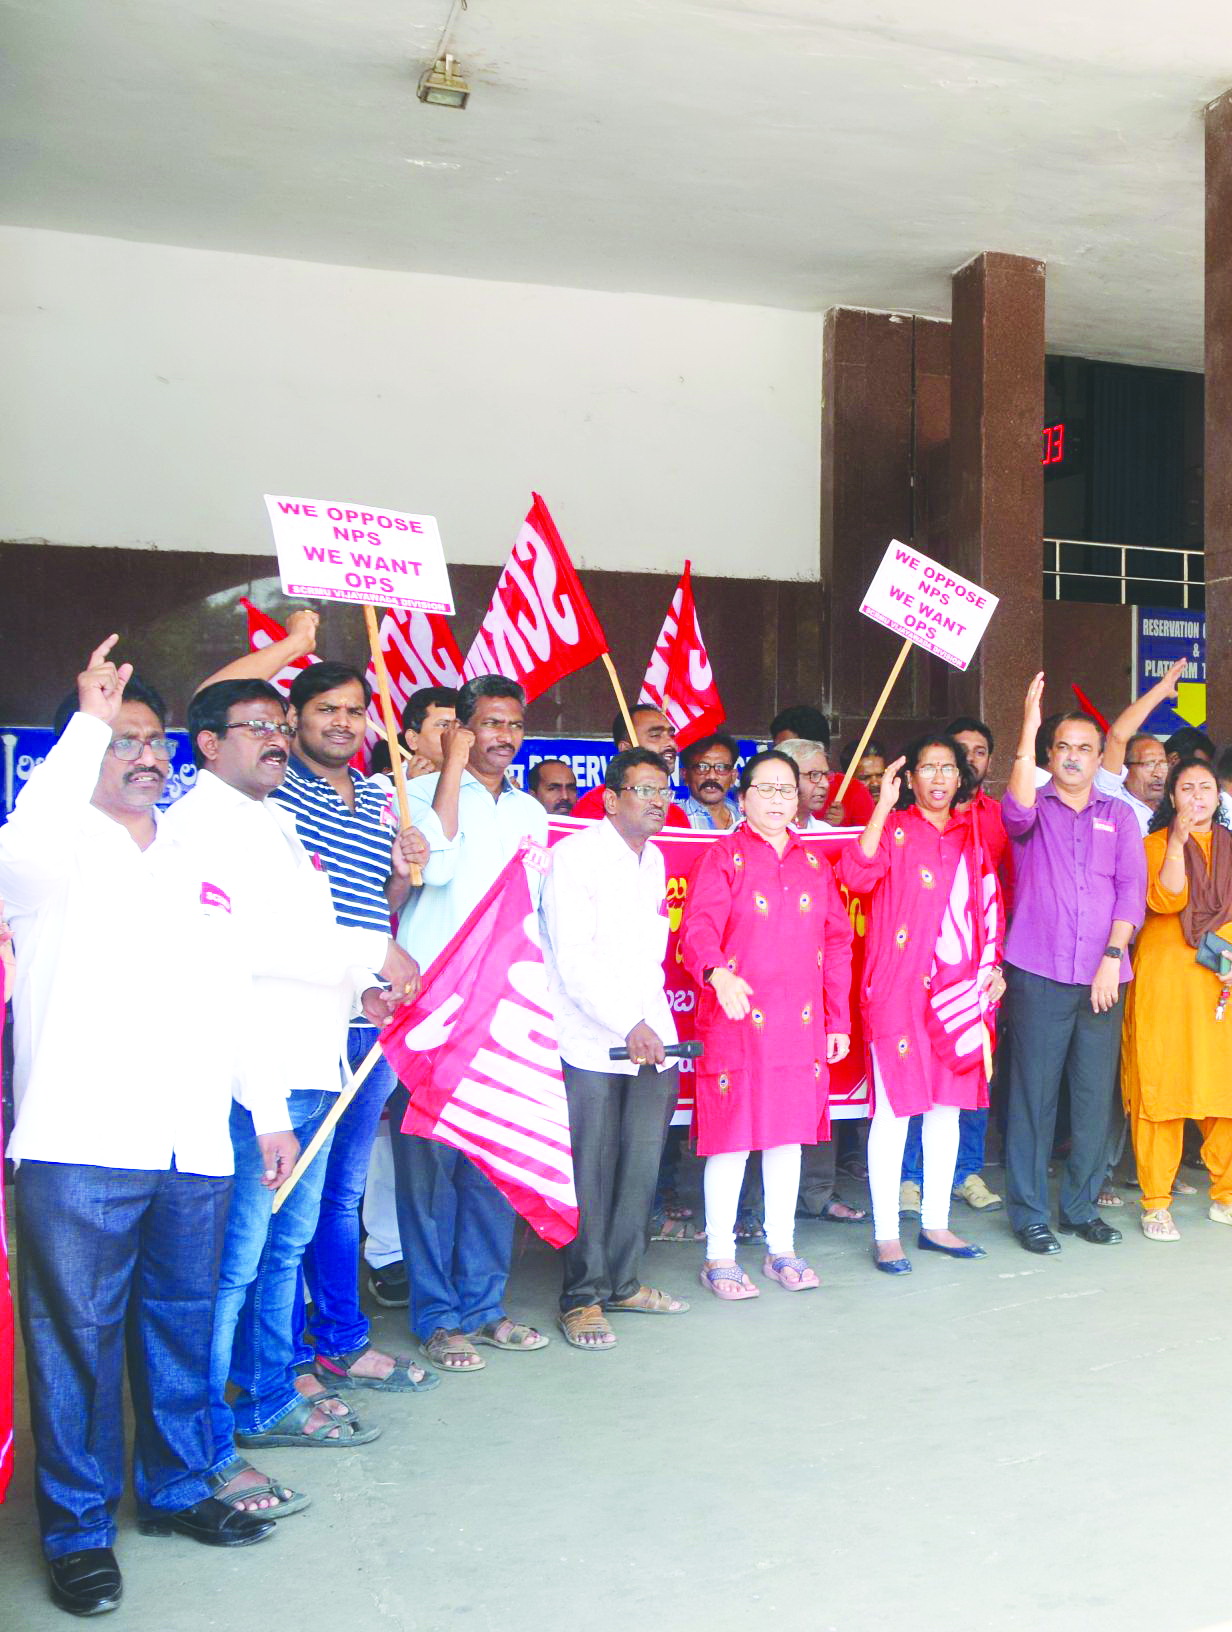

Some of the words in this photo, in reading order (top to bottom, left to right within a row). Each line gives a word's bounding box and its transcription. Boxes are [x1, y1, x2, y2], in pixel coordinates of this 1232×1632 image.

[278, 502, 318, 517] WE
[327, 508, 424, 534] OPPOSE
[333, 527, 381, 546] NPS
[304, 546, 343, 564] WE
[350, 552, 422, 576] WANT
[345, 572, 394, 593] OPS
[895, 549, 920, 570] WE
[924, 567, 987, 609] OPPOSE
[293, 586, 331, 596] SCRMU
[335, 590, 398, 605] VIJAYAWADA
[402, 599, 446, 611] DIVISION
[918, 580, 950, 605] NPS
[889, 585, 915, 608] WE
[919, 602, 967, 636] WANT
[904, 614, 937, 639] OPS
[1143, 619, 1200, 638] RESERVATION
[1193, 643, 1200, 657] &
[1145, 660, 1198, 679] PLATRM
